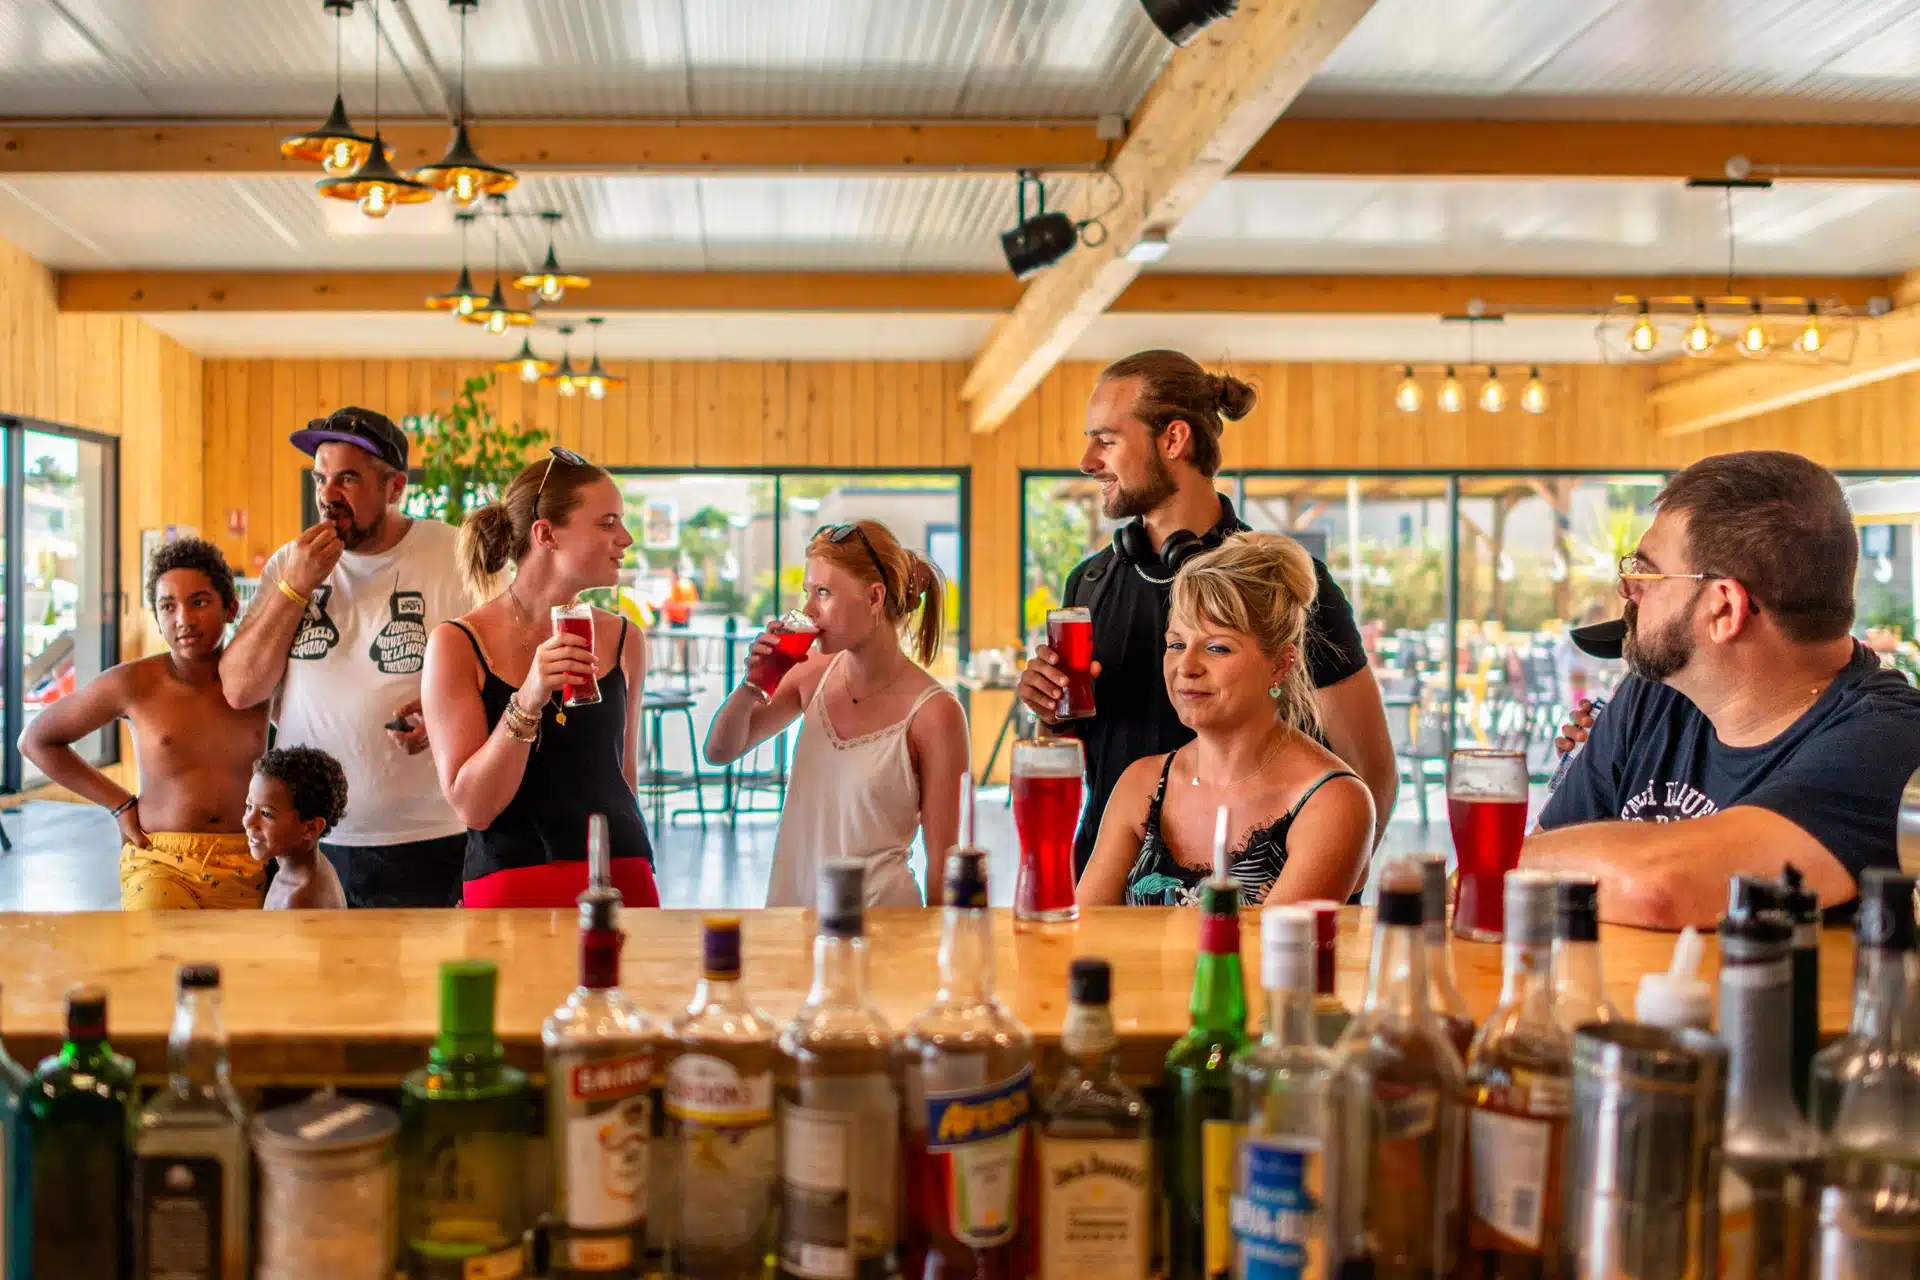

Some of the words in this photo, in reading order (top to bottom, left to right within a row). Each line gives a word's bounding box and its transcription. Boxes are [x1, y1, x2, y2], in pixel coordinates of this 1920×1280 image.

[385, 621, 424, 635] FOREMAN
[290, 639, 328, 658] CQUIAO
[381, 650, 392, 661] DE
[393, 646, 404, 660] LA
[383, 657, 422, 672] TRINIDAD
